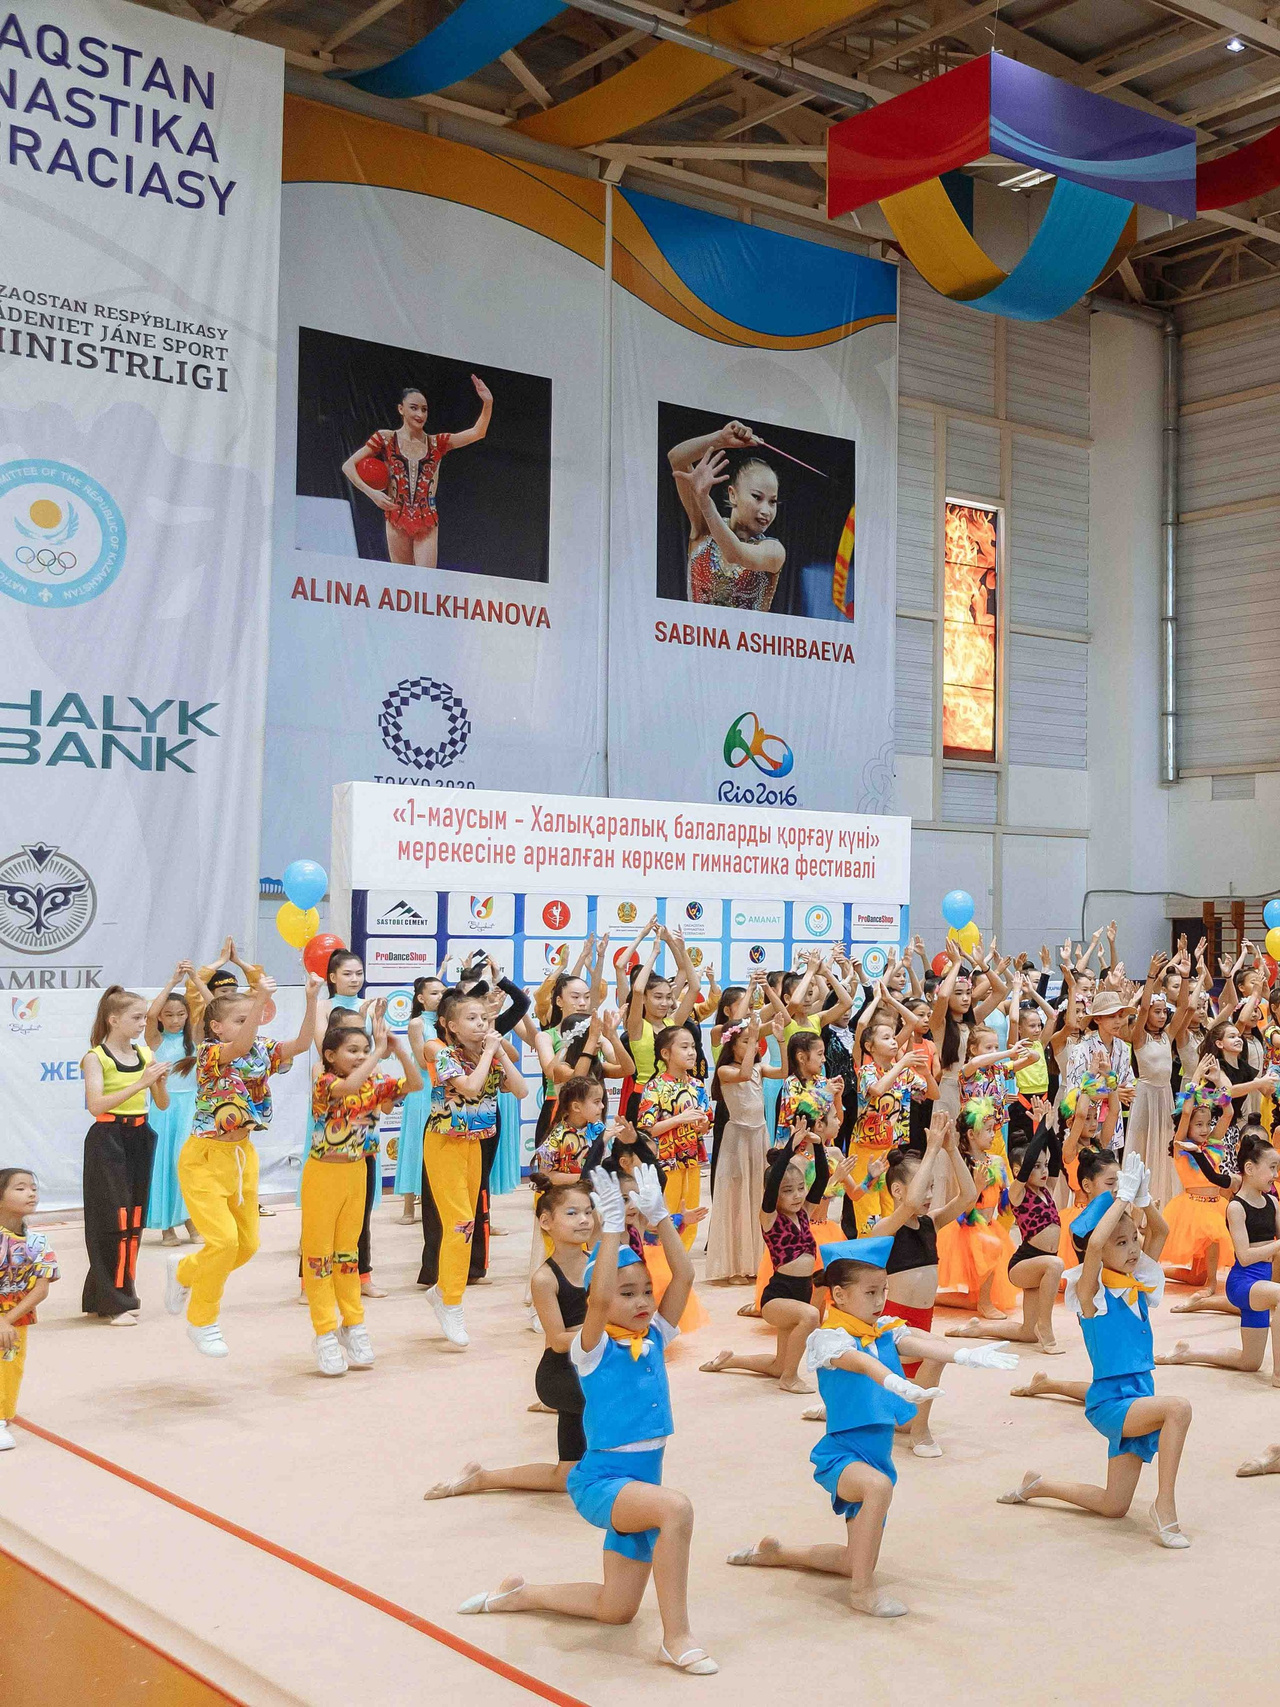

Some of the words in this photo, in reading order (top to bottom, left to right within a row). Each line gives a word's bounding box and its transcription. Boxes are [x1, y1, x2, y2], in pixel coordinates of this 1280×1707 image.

[0, 13, 215, 110] AQSTAN
[163, 337, 229, 362] SPORT
[291, 576, 371, 608] ALINA
[378, 587, 551, 629] ADILKHANOVA
[655, 621, 731, 650] SABINA
[737, 631, 856, 664] ASHIRBAEVA
[392, 798, 507, 835] «1-маусым
[531, 804, 668, 842] Халықаралық
[674, 813, 771, 848] балаларды
[777, 826, 833, 853] қорғау
[838, 825, 880, 854] күні»
[398, 836, 516, 868] мерекесіне
[523, 845, 615, 873] арналған
[622, 849, 685, 876] көркем
[692, 852, 789, 876] гимнастика
[795, 854, 876, 880] фестивалі
[748, 916, 781, 924] AMANAT
[375, 951, 427, 963] ProDanceShop
[40, 1061, 85, 1081] ЖЕ
